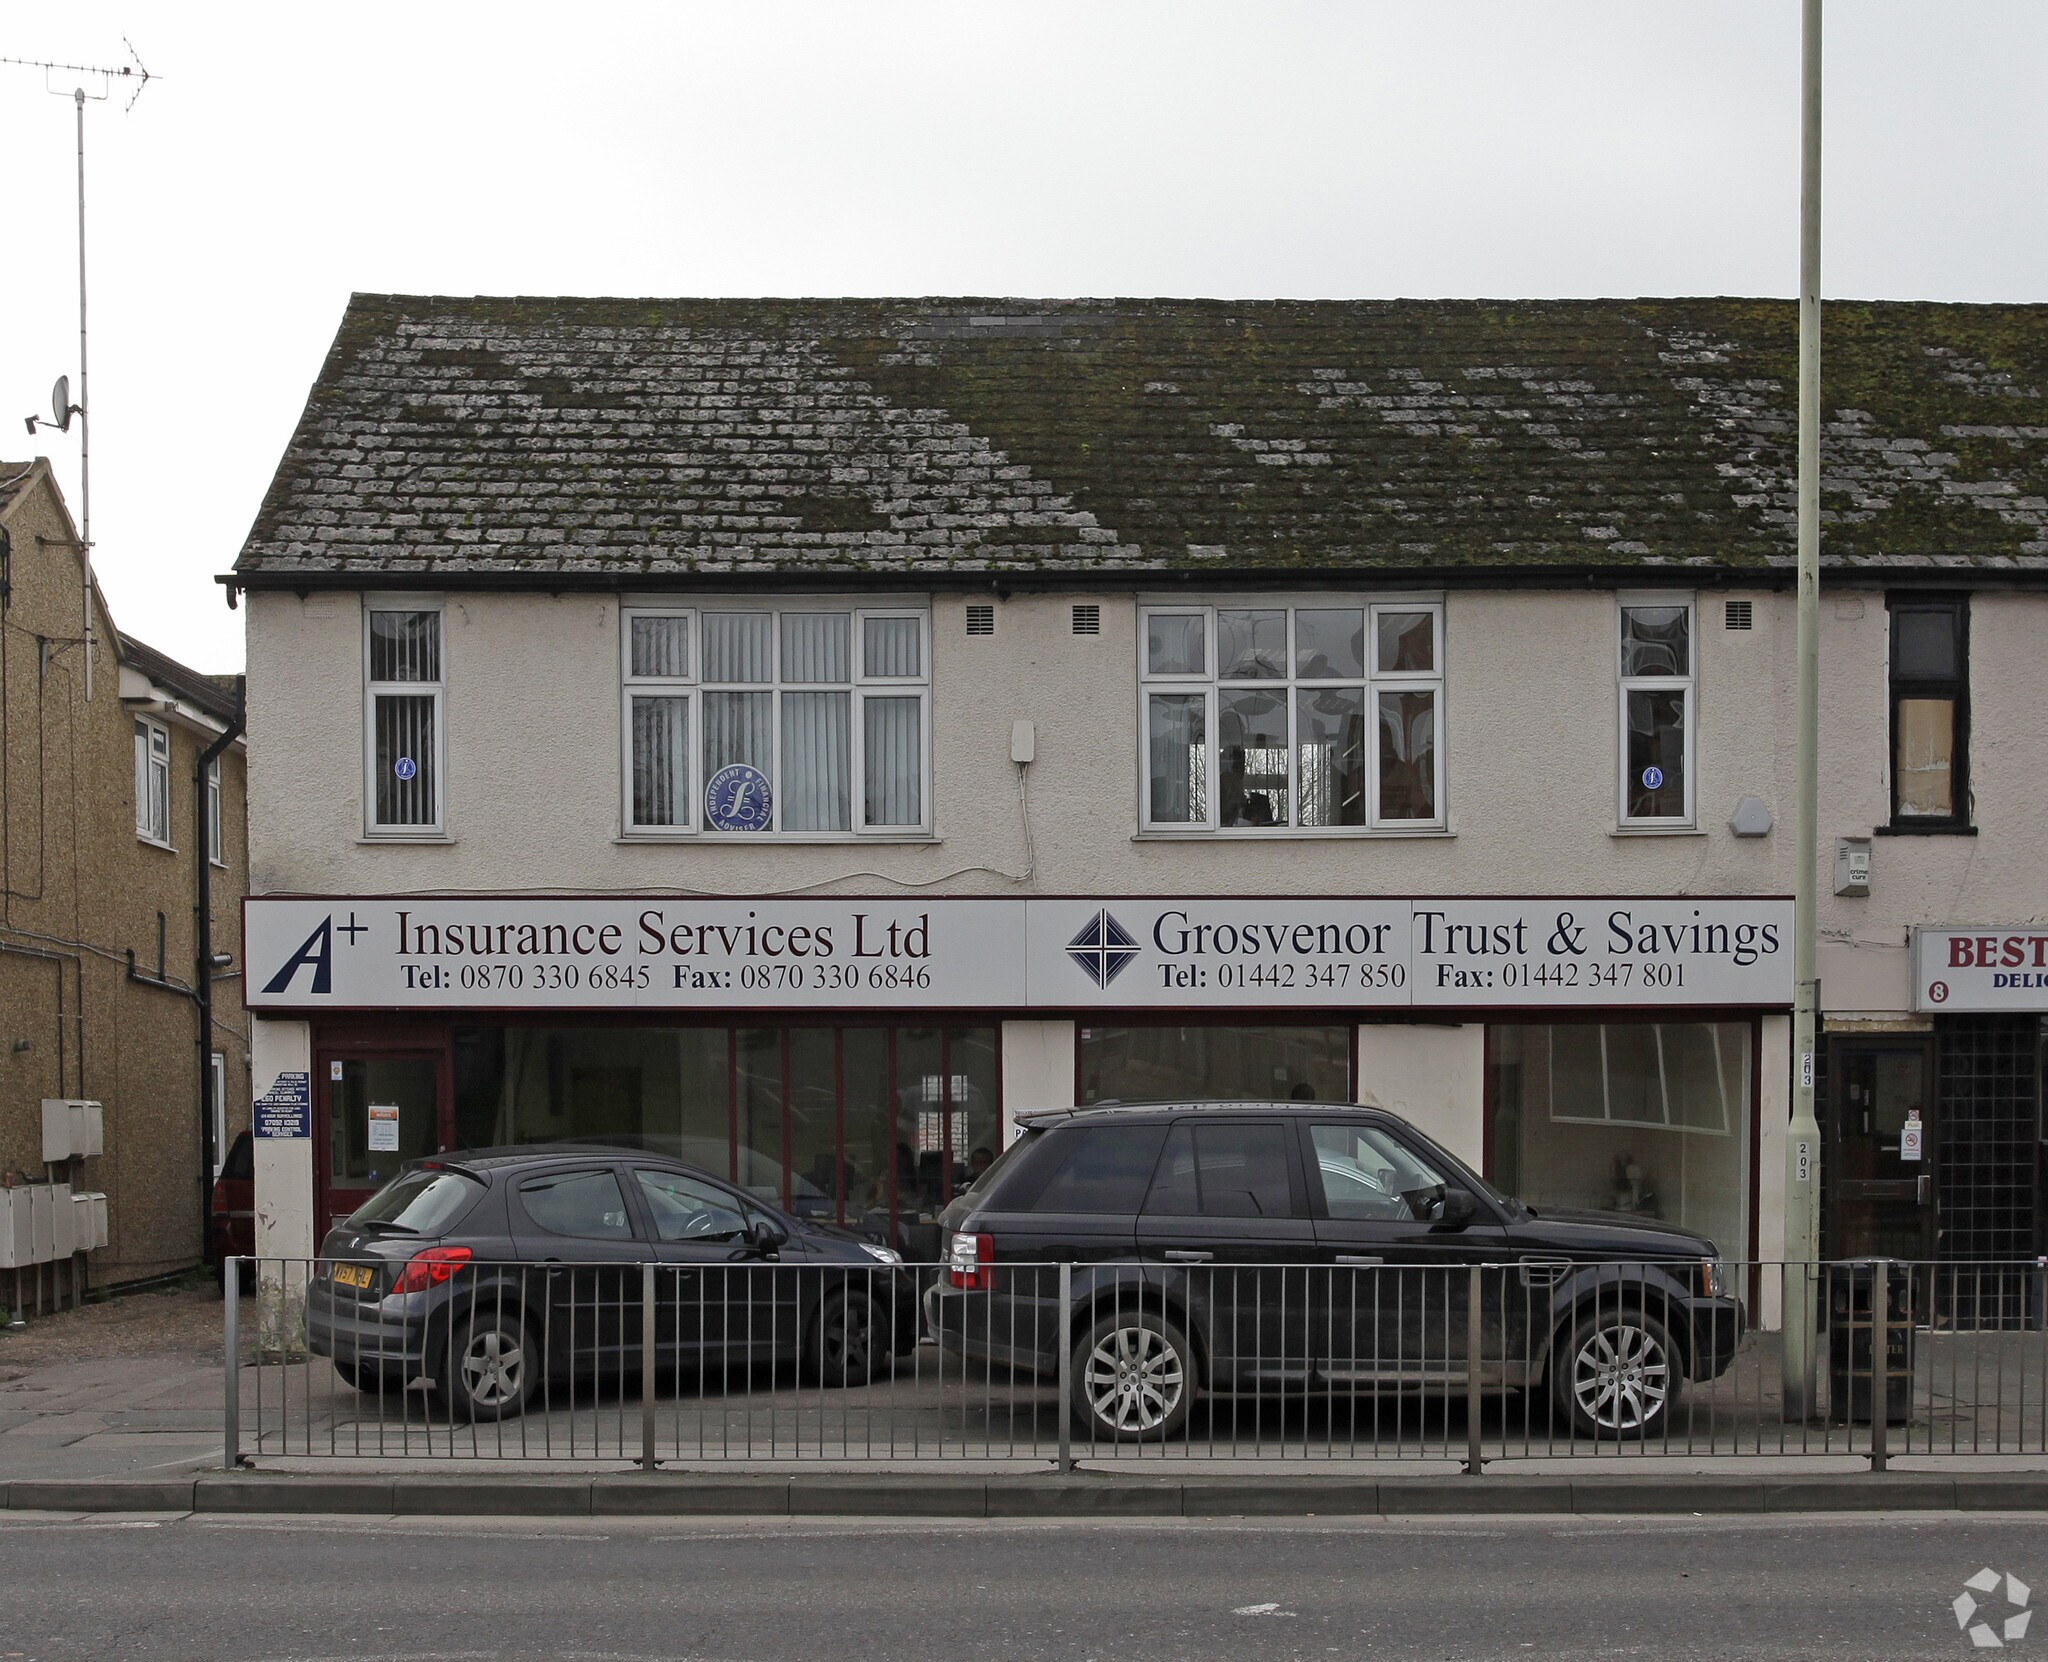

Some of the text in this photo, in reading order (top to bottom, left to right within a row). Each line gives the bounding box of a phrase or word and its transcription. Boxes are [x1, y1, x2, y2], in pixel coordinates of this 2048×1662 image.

[709, 768, 740, 816] INDEPENDENT
[755, 777, 770, 821] FINANCIAL
[395, 910, 932, 958] Insurance Services Ltd
[1152, 909, 1780, 965] Grosvenor Trust & Savings
[1948, 936, 2048, 968] BEST
[401, 964, 931, 990] Tel: 0870 330 6845 Fax: 0870 330 6846
[1158, 962, 1685, 988] Tel: 01442 347 850 Fax: 01442 347 801
[1799, 1143, 1808, 1179] 203
